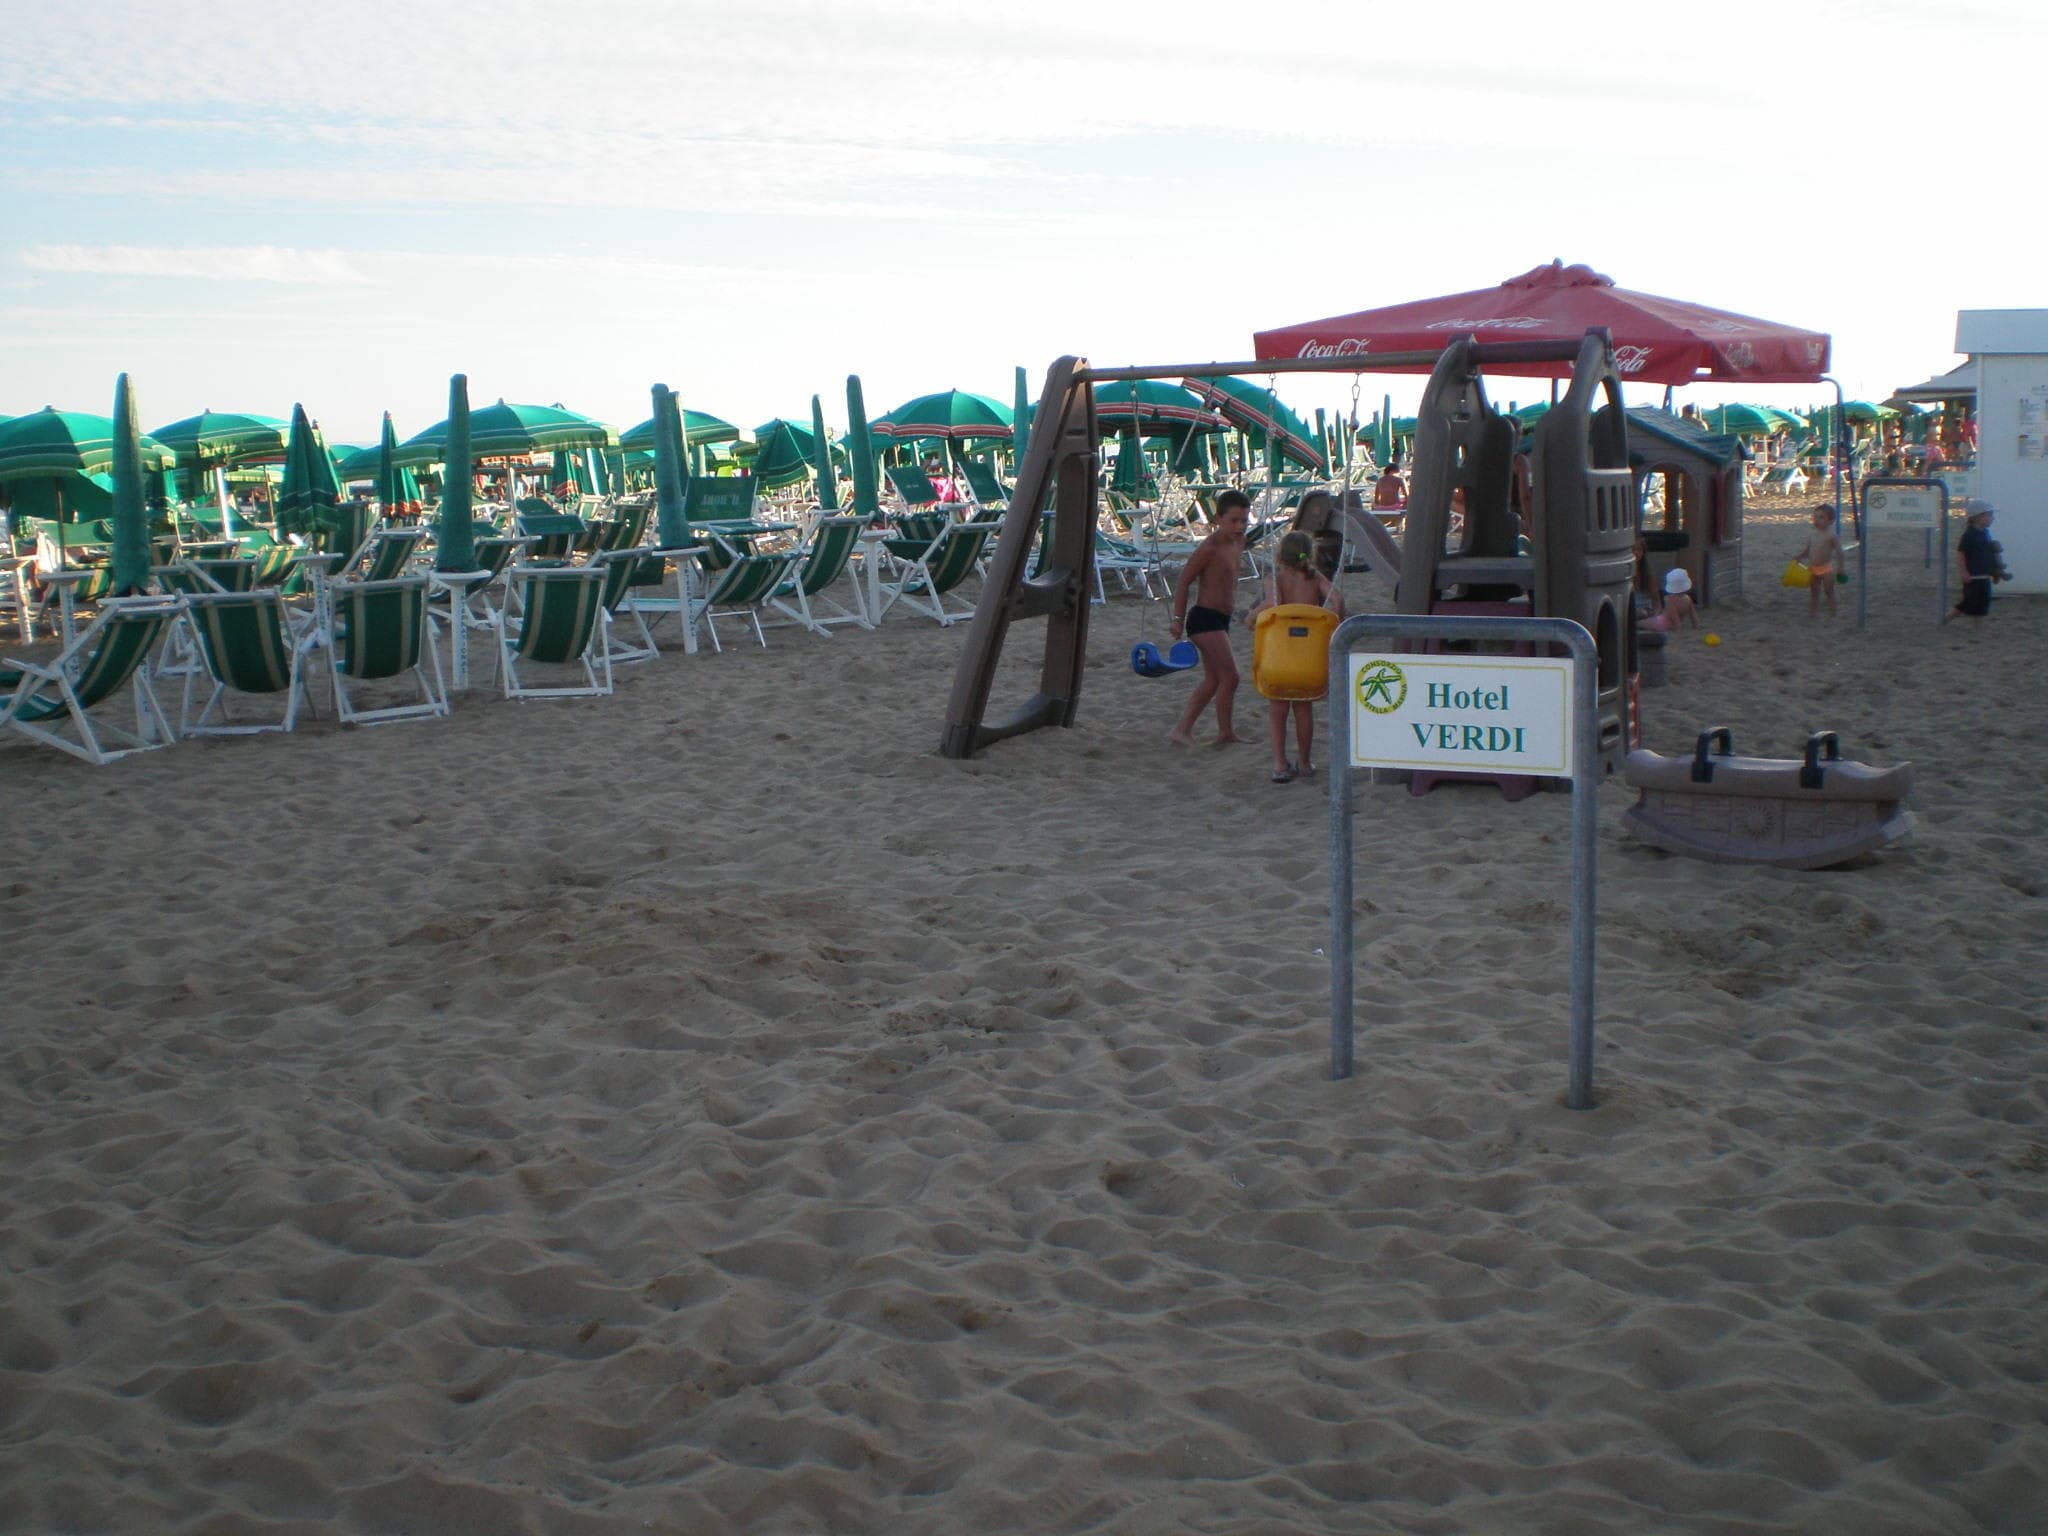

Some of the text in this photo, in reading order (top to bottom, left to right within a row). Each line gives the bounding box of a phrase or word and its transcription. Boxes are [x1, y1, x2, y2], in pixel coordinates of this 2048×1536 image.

[1361, 660, 1402, 675] CONSORZIO
[1426, 682, 1509, 710] Hotel
[1410, 723, 1526, 752] VERDI
